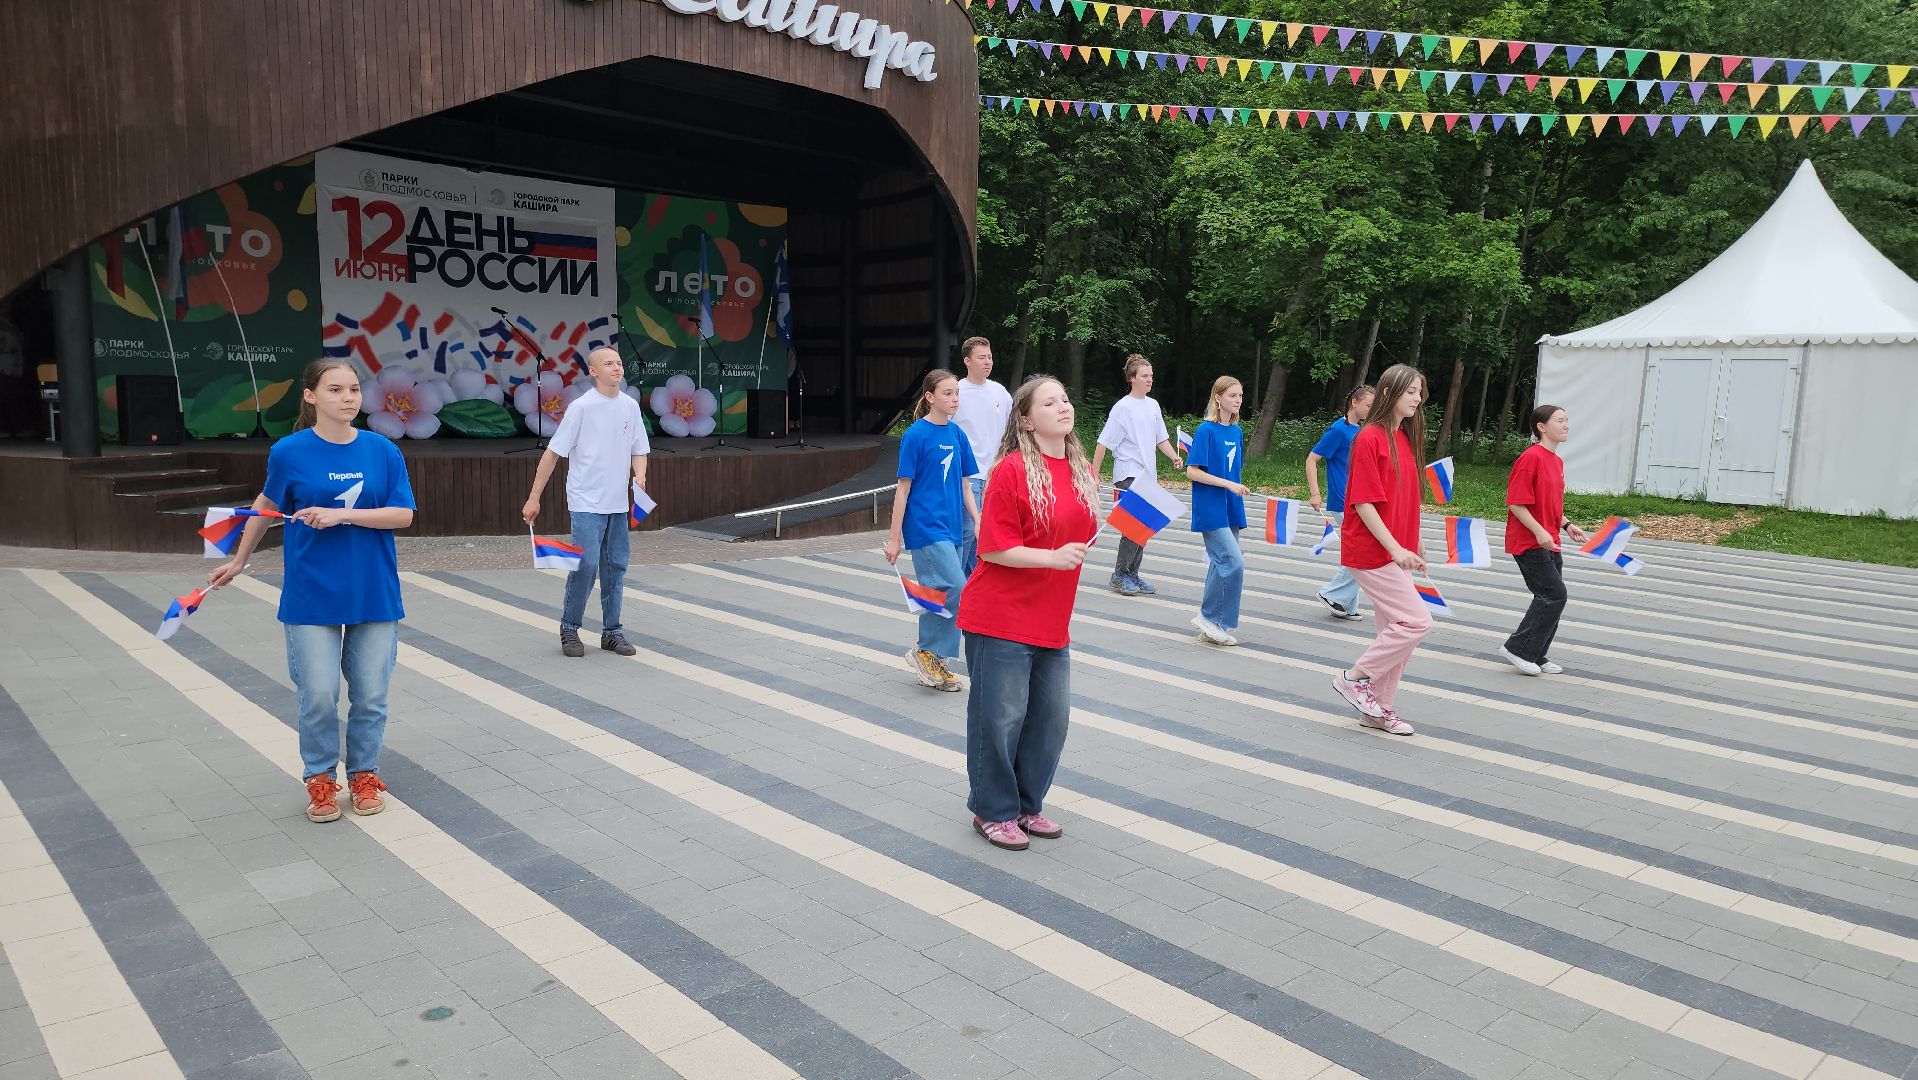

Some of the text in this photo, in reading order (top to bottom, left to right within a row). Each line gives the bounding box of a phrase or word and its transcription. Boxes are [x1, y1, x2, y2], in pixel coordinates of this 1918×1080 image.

[571, 0, 938, 89] ашира
[381, 171, 418, 185] ПАРКИ
[381, 183, 467, 203] ПОДМОСКОВЬЯ
[513, 192, 580, 206] ГОРОДСКОЙ ПАРК
[513, 199, 559, 213] КАШИРА
[331, 196, 408, 265] 12
[405, 206, 535, 255] ДЕНЬ
[335, 257, 409, 283] ИЮНЯ
[406, 245, 599, 298] РОССИИ
[109, 339, 144, 349] ПАРКИ
[227, 351, 277, 363] КАШИРА
[328, 472, 364, 482] Первые
